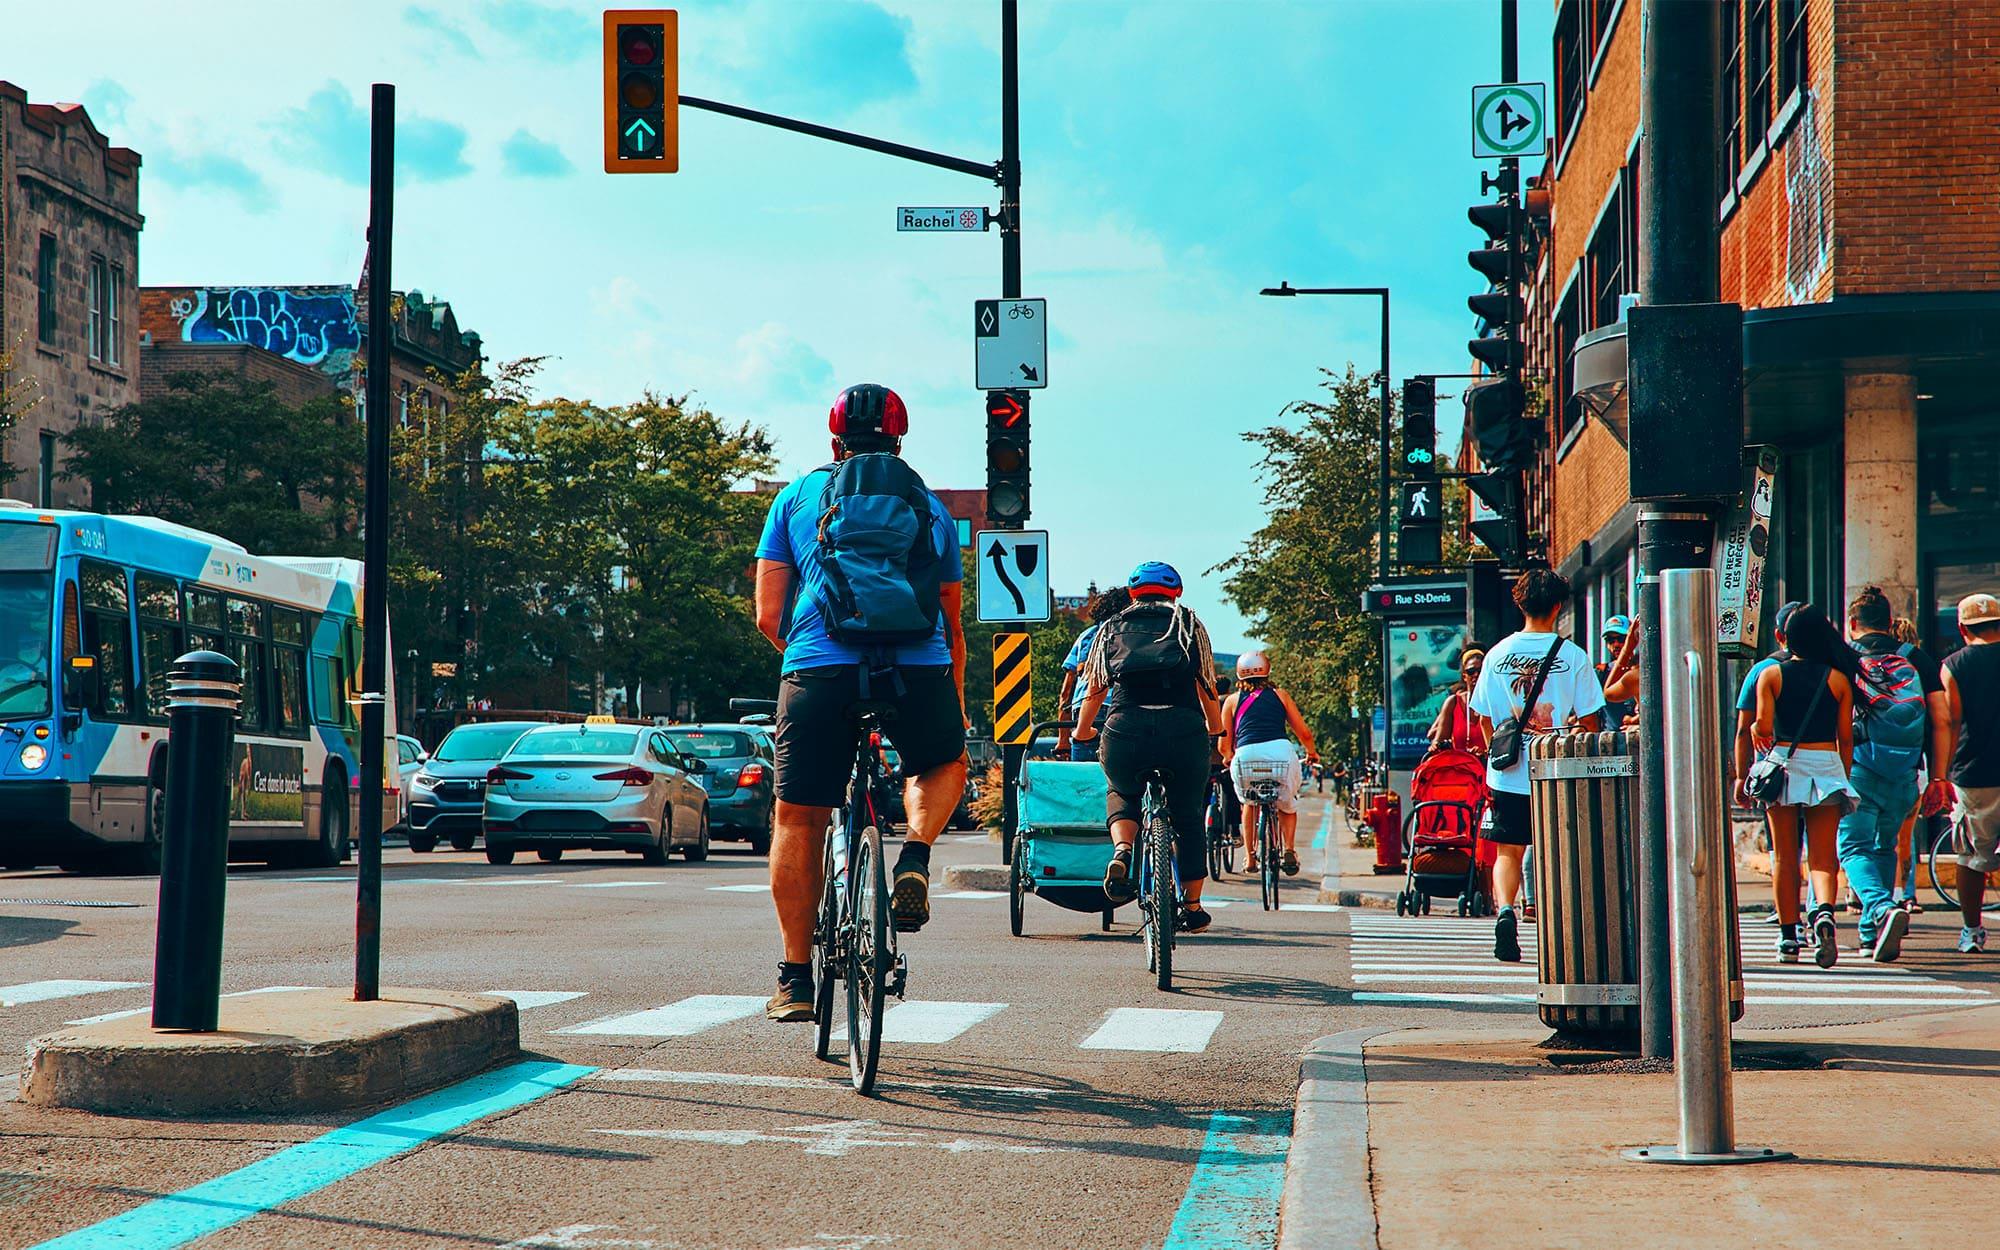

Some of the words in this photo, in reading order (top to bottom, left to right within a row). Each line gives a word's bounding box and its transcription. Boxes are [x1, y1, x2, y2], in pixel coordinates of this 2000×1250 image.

[904, 215, 955, 228] Rachel
[1727, 527, 1738, 569] RECYCLE
[1724, 572, 1733, 590] ON
[1732, 570, 1742, 588] LES
[1395, 594, 1413, 605] Rue
[1414, 592, 1452, 604] St-Denis
